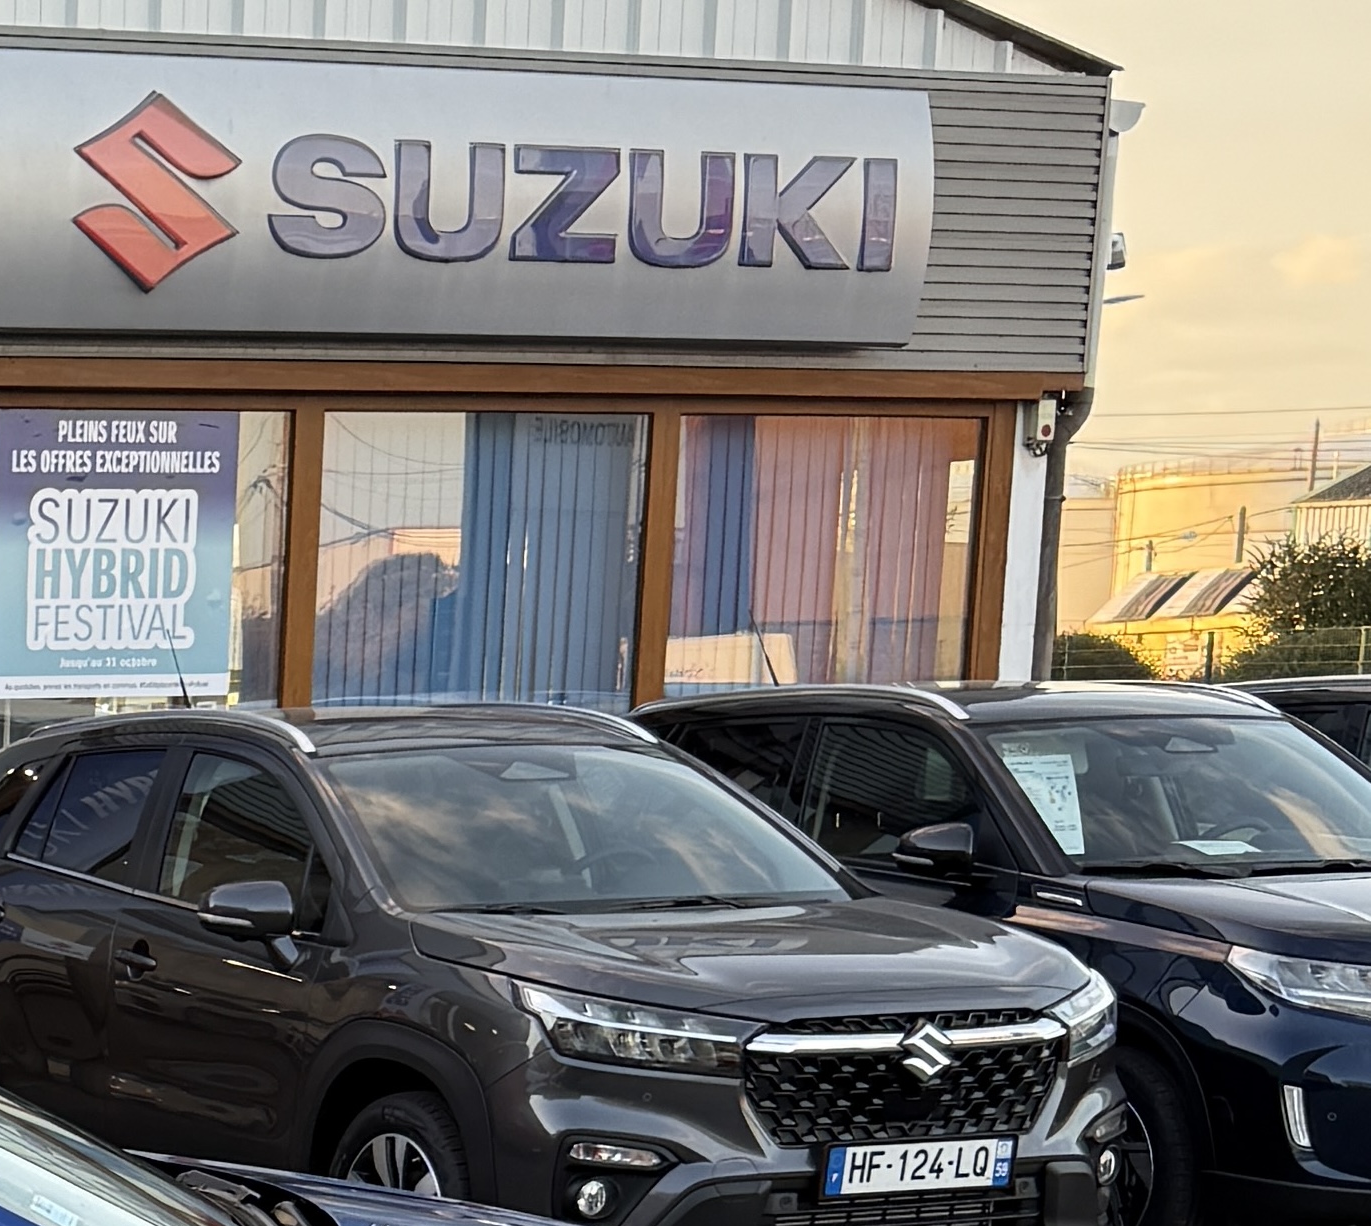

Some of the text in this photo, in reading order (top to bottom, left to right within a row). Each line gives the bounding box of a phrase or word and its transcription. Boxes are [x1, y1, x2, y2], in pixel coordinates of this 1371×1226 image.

[267, 132, 898, 273] SUZUKI
[58, 420, 177, 444] PLEINS FEUX SUR
[12, 449, 221, 474] LES OFFRES EXCEPTIONNELLES
[35, 497, 191, 544] SUZUKI
[34, 548, 189, 600] HYBRID
[34, 603, 187, 642] FESTIVAL
[119, 657, 157, 668] octobre
[848, 1146, 990, 1184] HF-124-LQ
[994, 1162, 1009, 1178] 59
